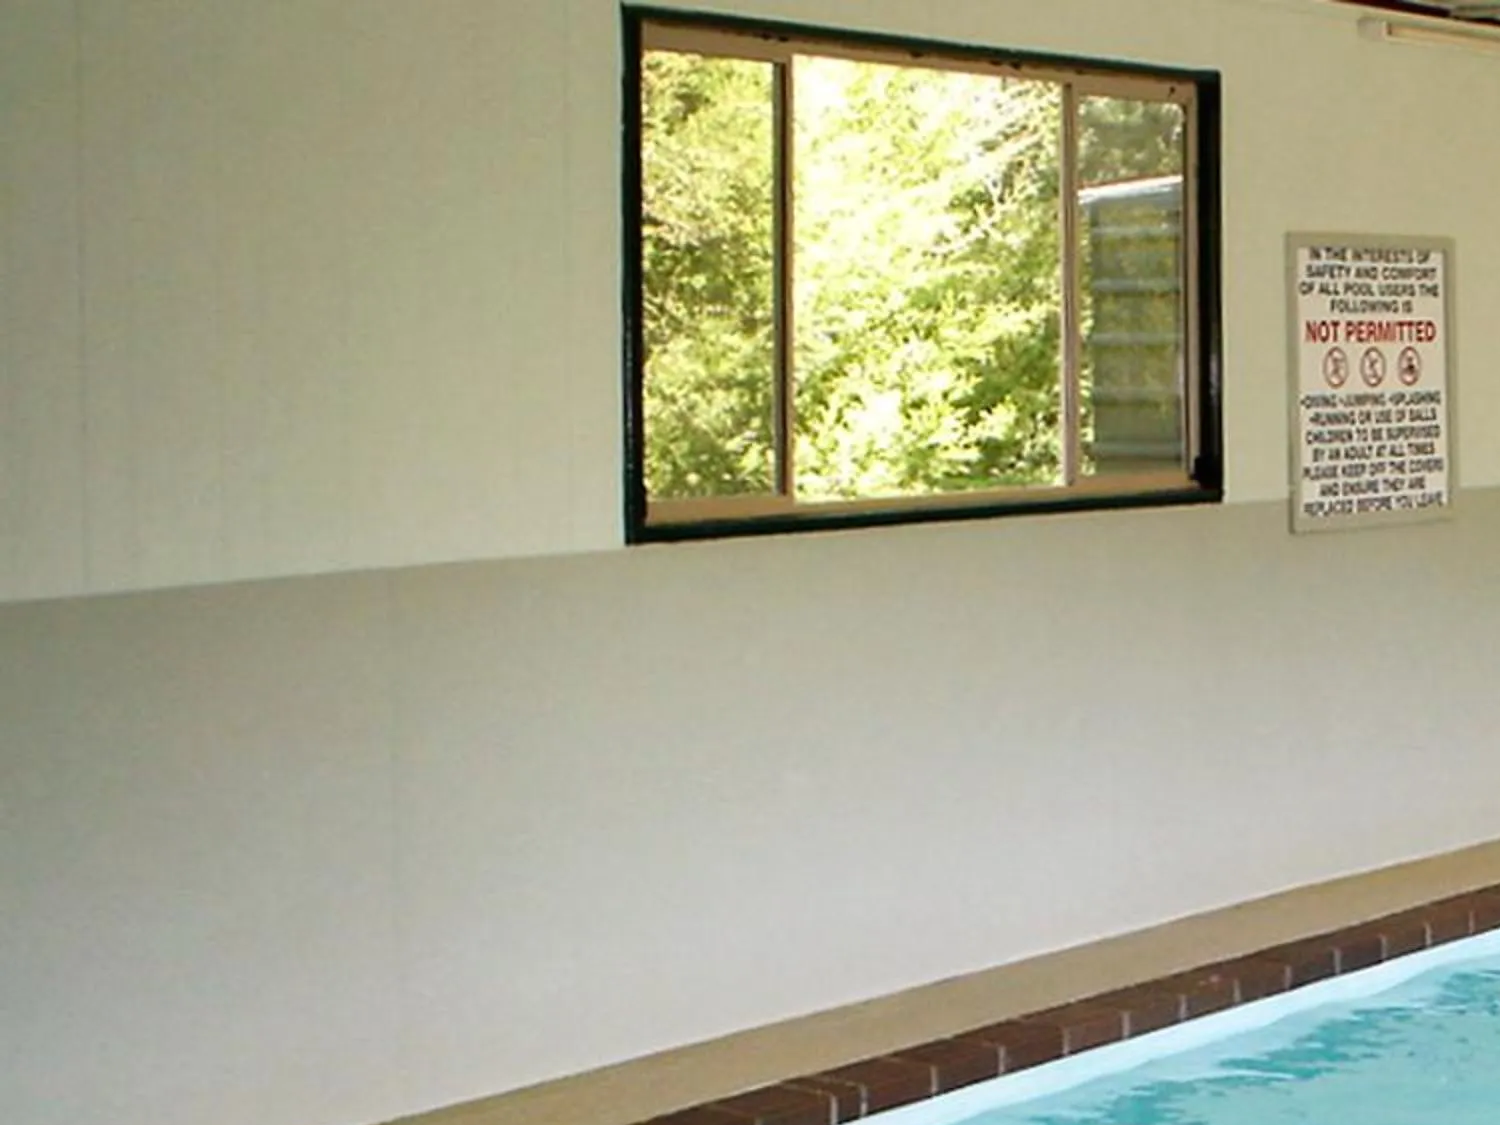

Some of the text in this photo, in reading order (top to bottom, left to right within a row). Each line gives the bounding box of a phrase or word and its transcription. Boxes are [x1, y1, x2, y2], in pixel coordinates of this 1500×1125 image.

[1310, 247, 1430, 264] IN THE INTERESTS OF
[1306, 265, 1437, 280] SAFETY AND COMFORT
[1299, 282, 1439, 297] OF ALL POOL USERS THE
[1330, 300, 1412, 313] FOLLOWING IS
[1306, 321, 1436, 342] NOT PERMITTED
[1358, 410, 1371, 424] OR
[1375, 409, 1392, 423] USE
[1395, 408, 1405, 422] OF
[1409, 408, 1436, 422] BALLS
[1306, 425, 1440, 444] CHILDREN TO BE SUPERVISED
[1313, 442, 1434, 462] BY AN ADULT AT ALL TIMES
[1303, 458, 1443, 480] PLEASE KEEP OFF THE COVERS
[1320, 477, 1425, 496] AND ENSURE THEY ARE
[1304, 491, 1442, 516] REPLACED BEFORE YOU LEAVE
